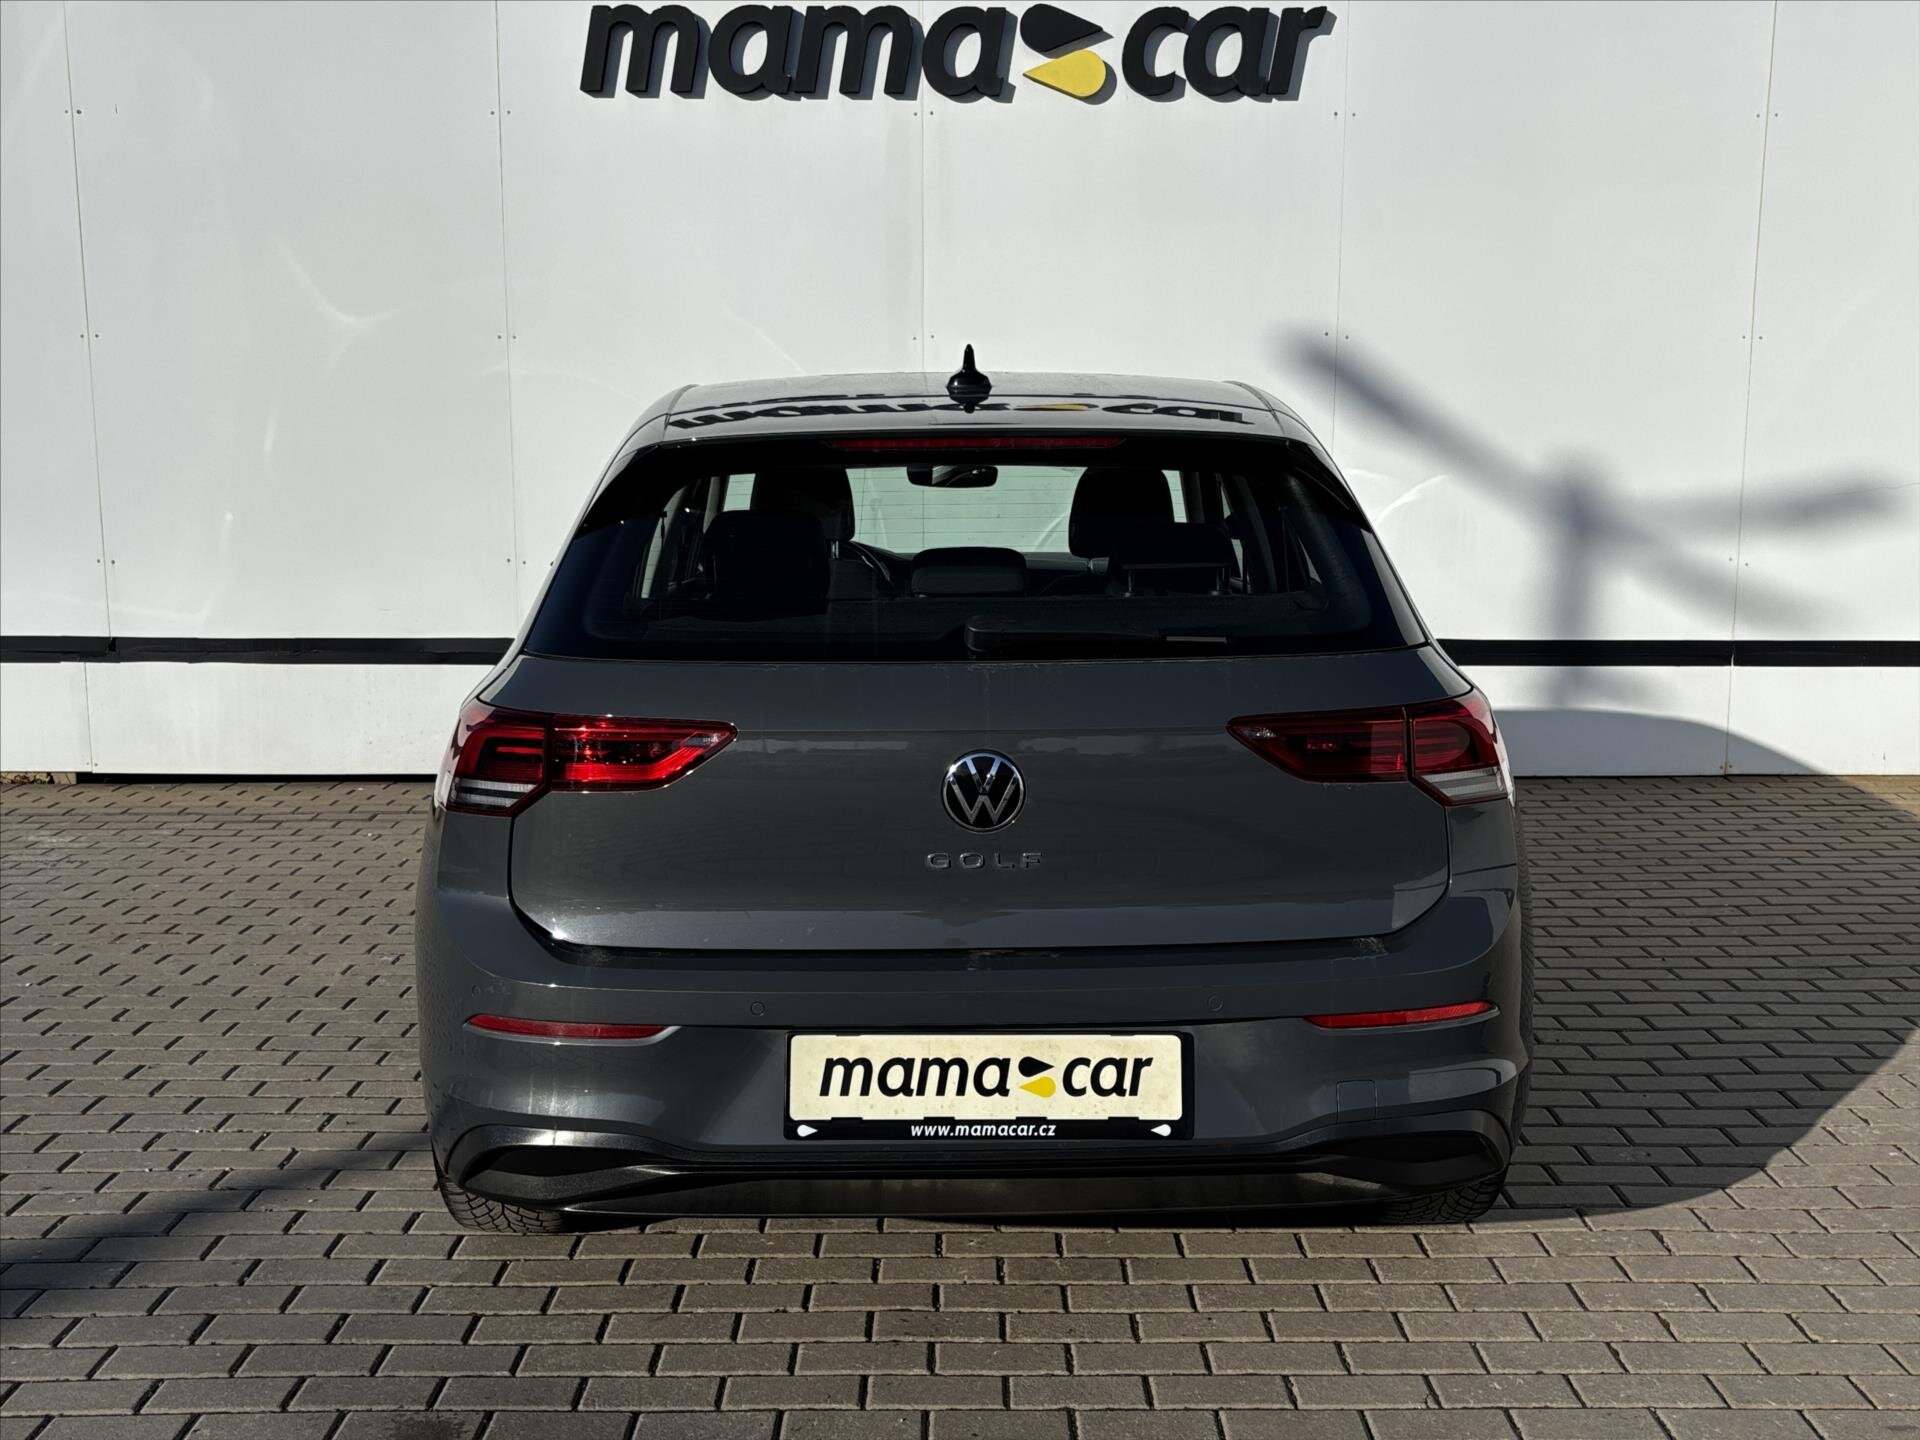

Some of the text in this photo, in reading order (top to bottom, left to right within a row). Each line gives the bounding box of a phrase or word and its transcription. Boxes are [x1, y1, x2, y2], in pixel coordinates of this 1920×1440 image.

[581, 4, 1327, 97] mama car
[926, 852, 1042, 869] GOLF
[819, 1056, 1153, 1097] mama car
[911, 1123, 1056, 1137] www.mamacar.cz
